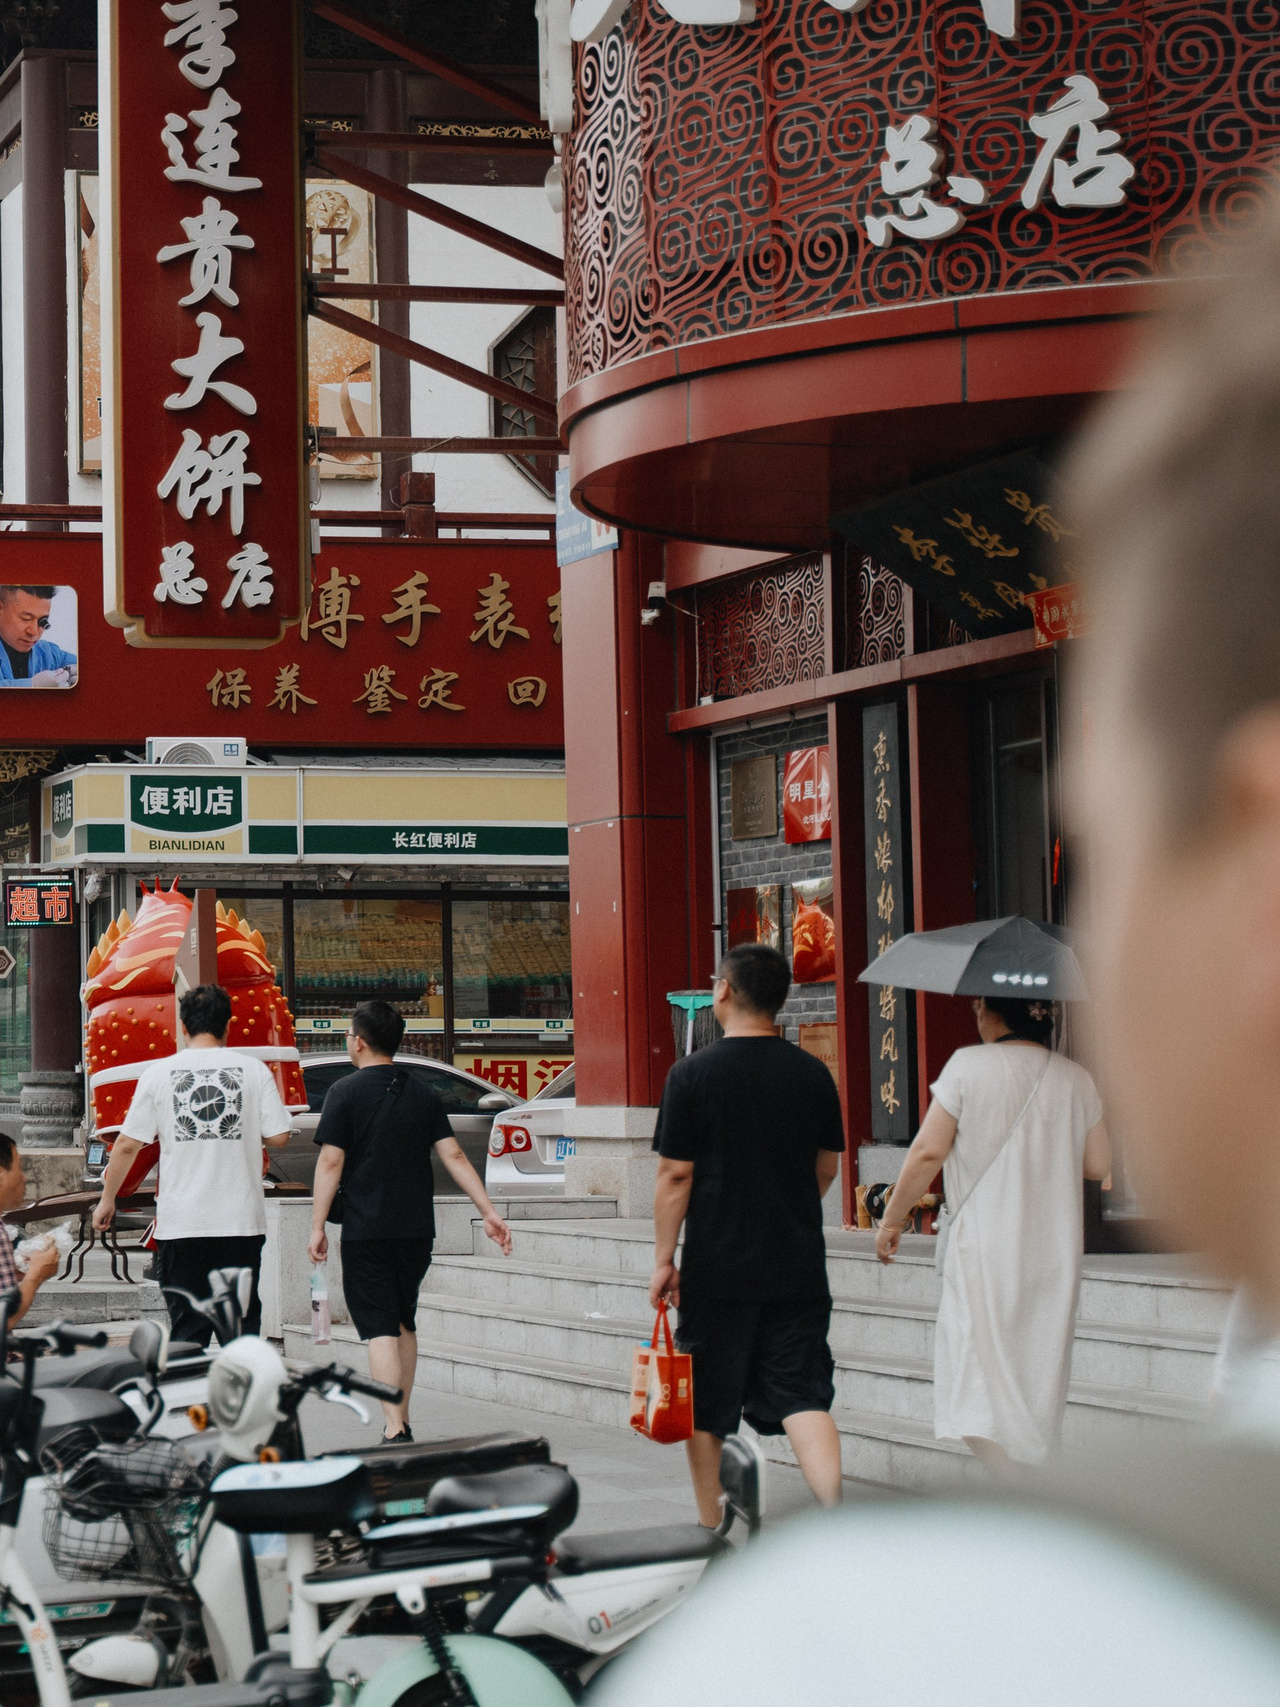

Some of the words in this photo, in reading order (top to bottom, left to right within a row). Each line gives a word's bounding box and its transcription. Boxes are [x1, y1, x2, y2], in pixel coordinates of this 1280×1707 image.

[865, 75, 1135, 248] 总店
[156, 0, 263, 536] 李连贵大饼
[153, 541, 274, 609] 总店
[206, 663, 318, 714] 保养
[352, 664, 466, 714] 鉴定
[53, 791, 72, 823] 便利店
[139, 785, 234, 815] 便利店
[149, 840, 225, 851] BIANLIDIAN
[392, 831, 477, 849] 长红便利店
[10, 886, 70, 922] 超市
